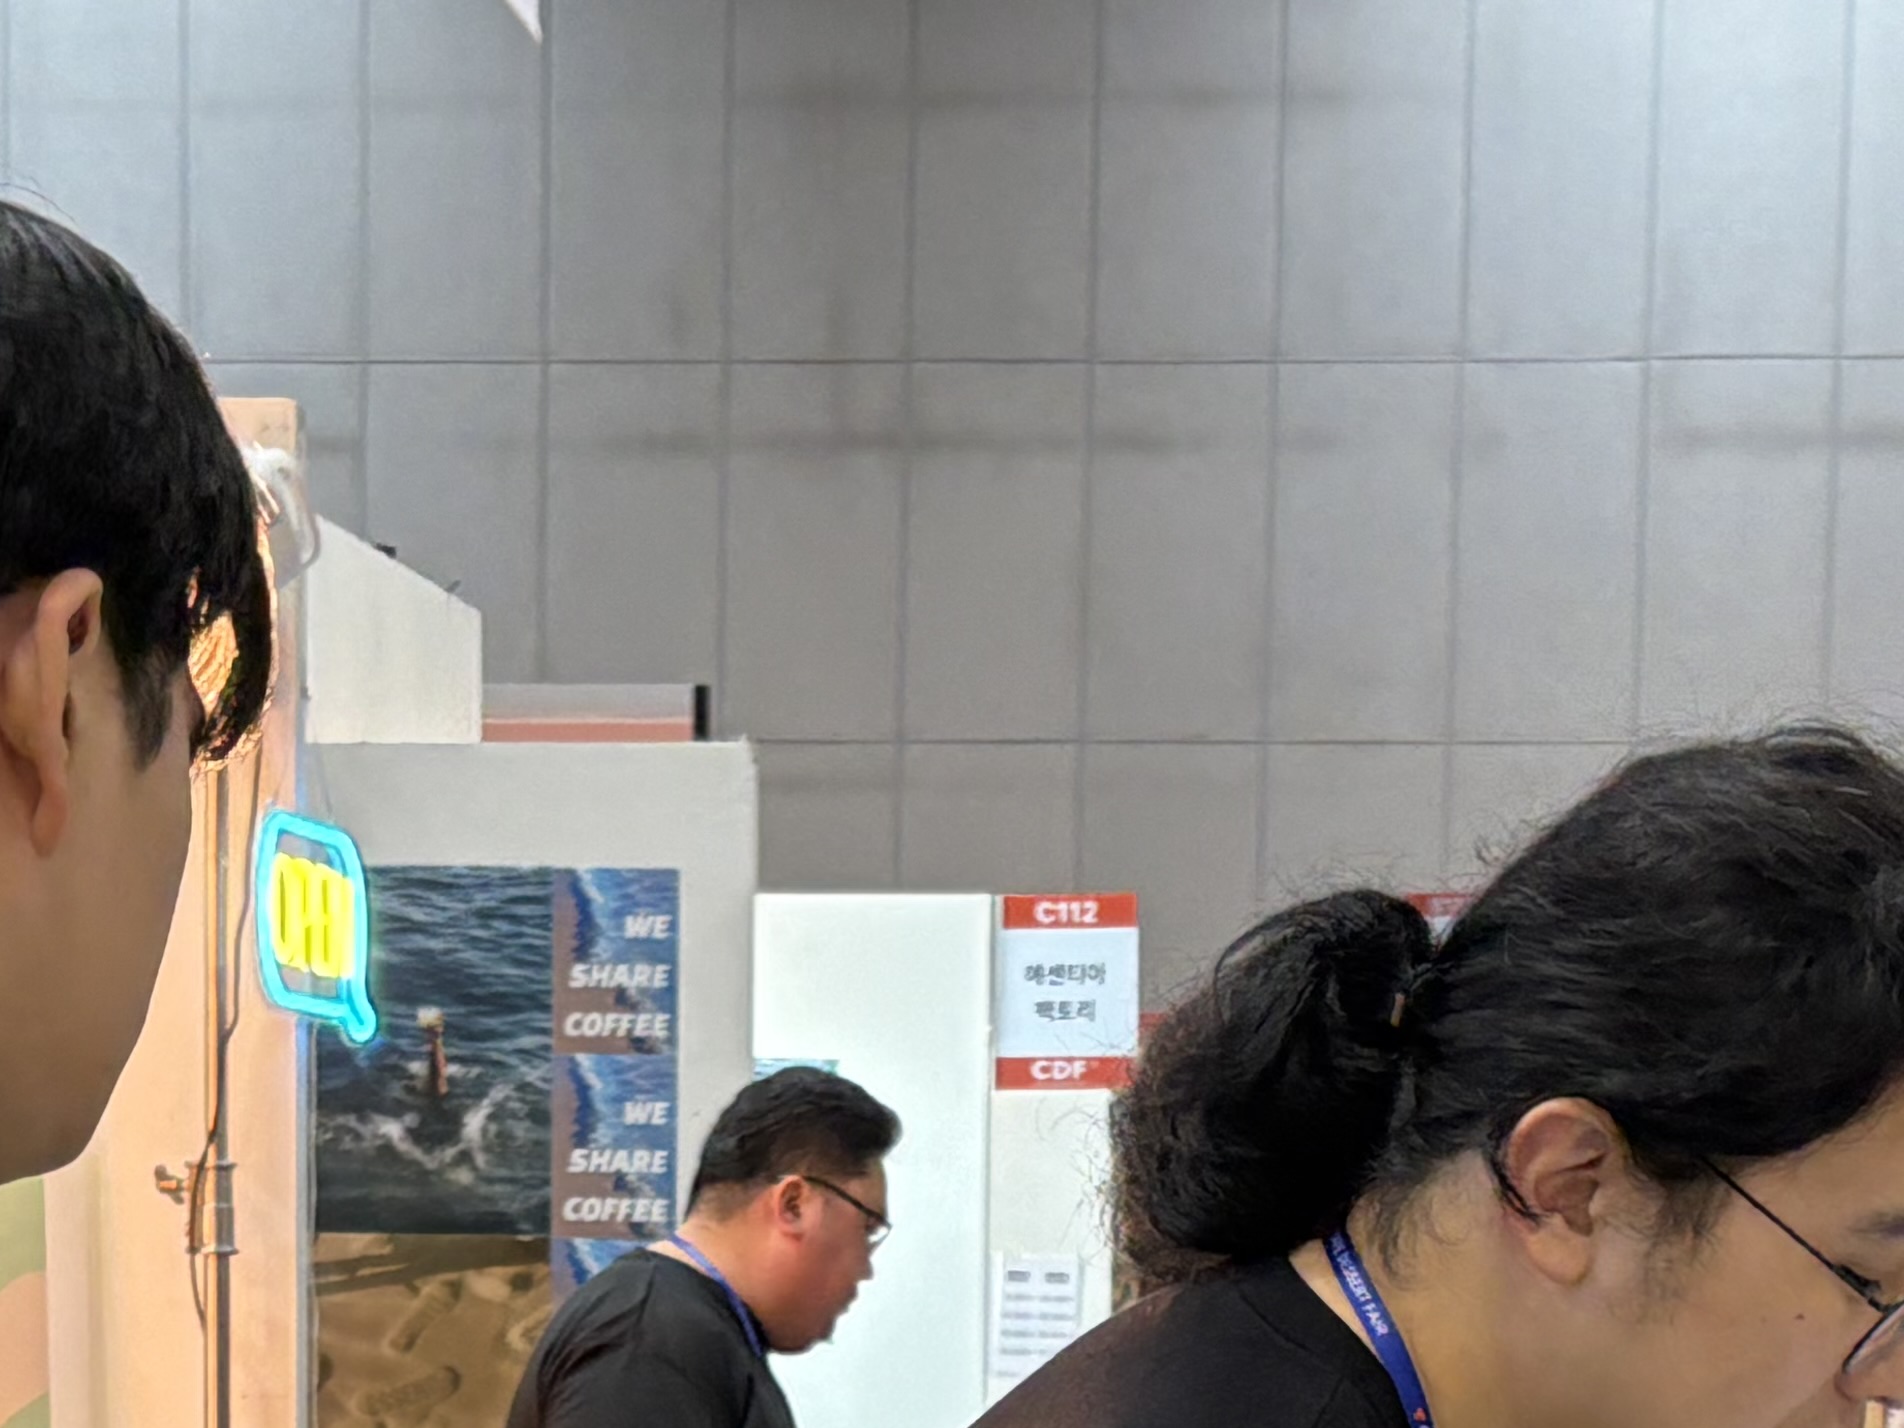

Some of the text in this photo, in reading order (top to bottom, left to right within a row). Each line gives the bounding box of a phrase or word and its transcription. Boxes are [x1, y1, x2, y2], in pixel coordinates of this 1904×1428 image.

[1033, 901, 1100, 925] C112
[624, 914, 673, 940] WE
[568, 963, 672, 989] SHARE
[563, 1011, 671, 1038] COFFEE
[1030, 1060, 1086, 1081] CDF
[624, 1101, 671, 1126] WE
[567, 1148, 670, 1174] SHARE
[562, 1197, 671, 1223] COFFEE
